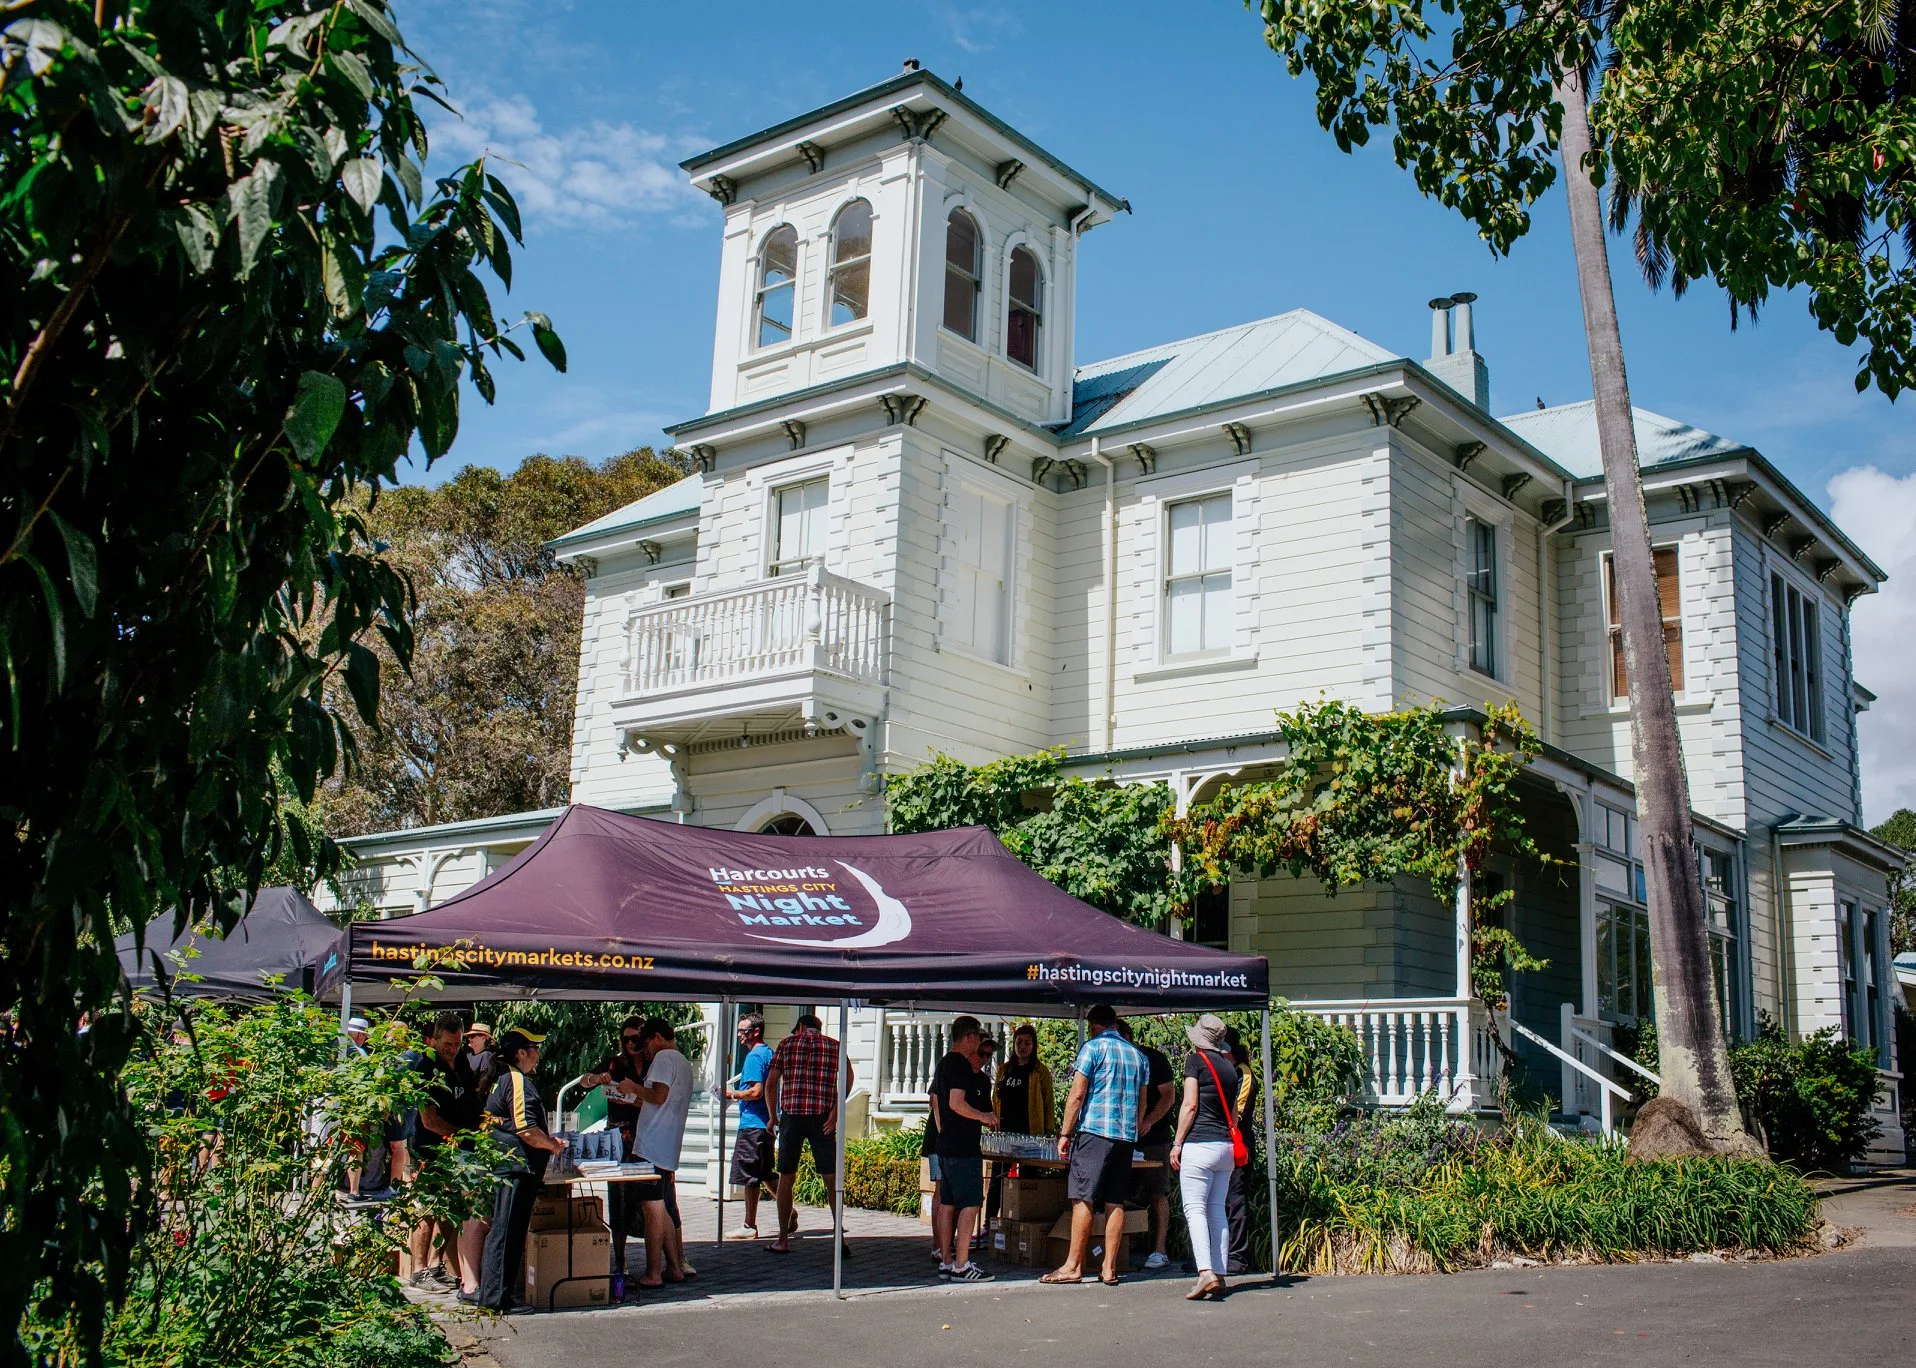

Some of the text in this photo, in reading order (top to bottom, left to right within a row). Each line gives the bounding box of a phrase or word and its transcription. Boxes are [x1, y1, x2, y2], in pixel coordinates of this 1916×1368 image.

[709, 866, 829, 882] Harcourts
[718, 883, 836, 893] HASTINGS CITY
[724, 891, 851, 915] Night
[737, 912, 863, 926] Market
[1027, 964, 1248, 988] #hastingscitynightmarket
